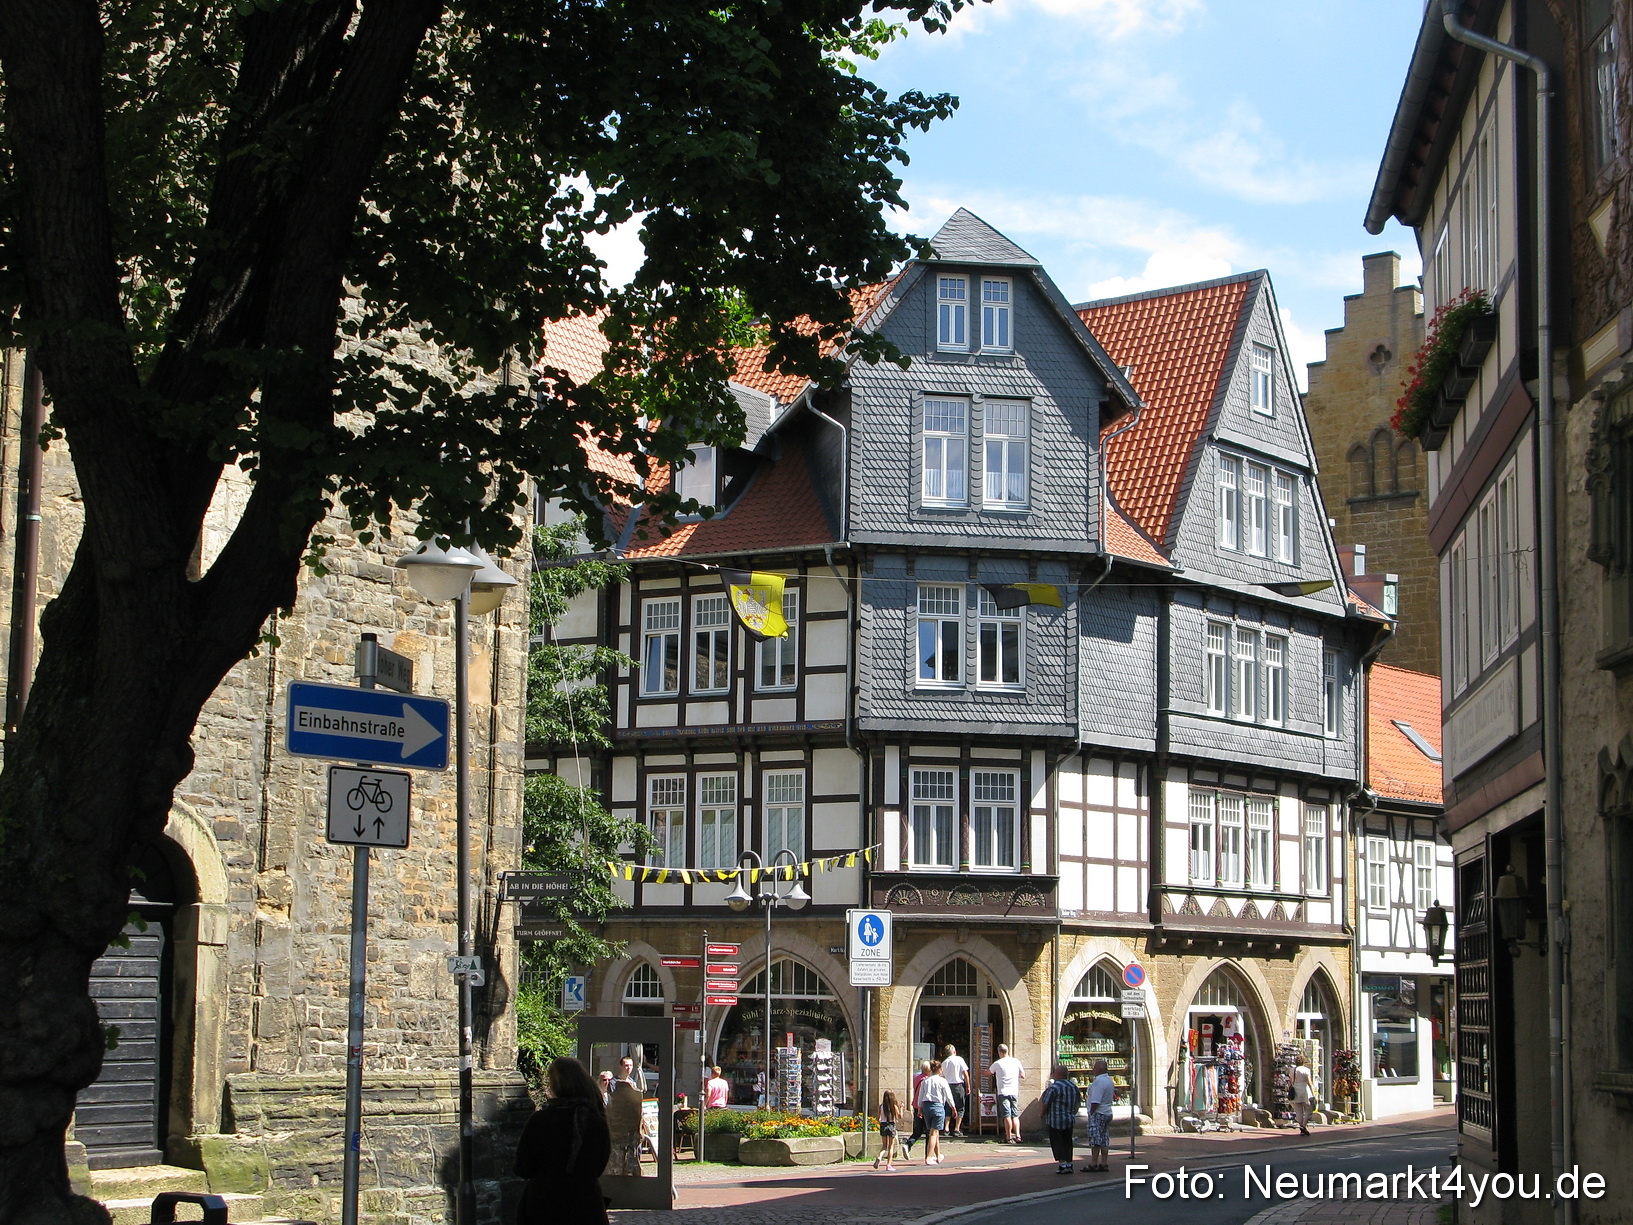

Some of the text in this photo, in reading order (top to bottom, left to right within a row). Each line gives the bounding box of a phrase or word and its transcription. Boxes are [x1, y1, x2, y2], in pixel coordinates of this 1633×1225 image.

[299, 711, 405, 738] Einbahnstraße
[545, 881, 568, 890] HÖHE!
[860, 948, 881, 957] ZONE
